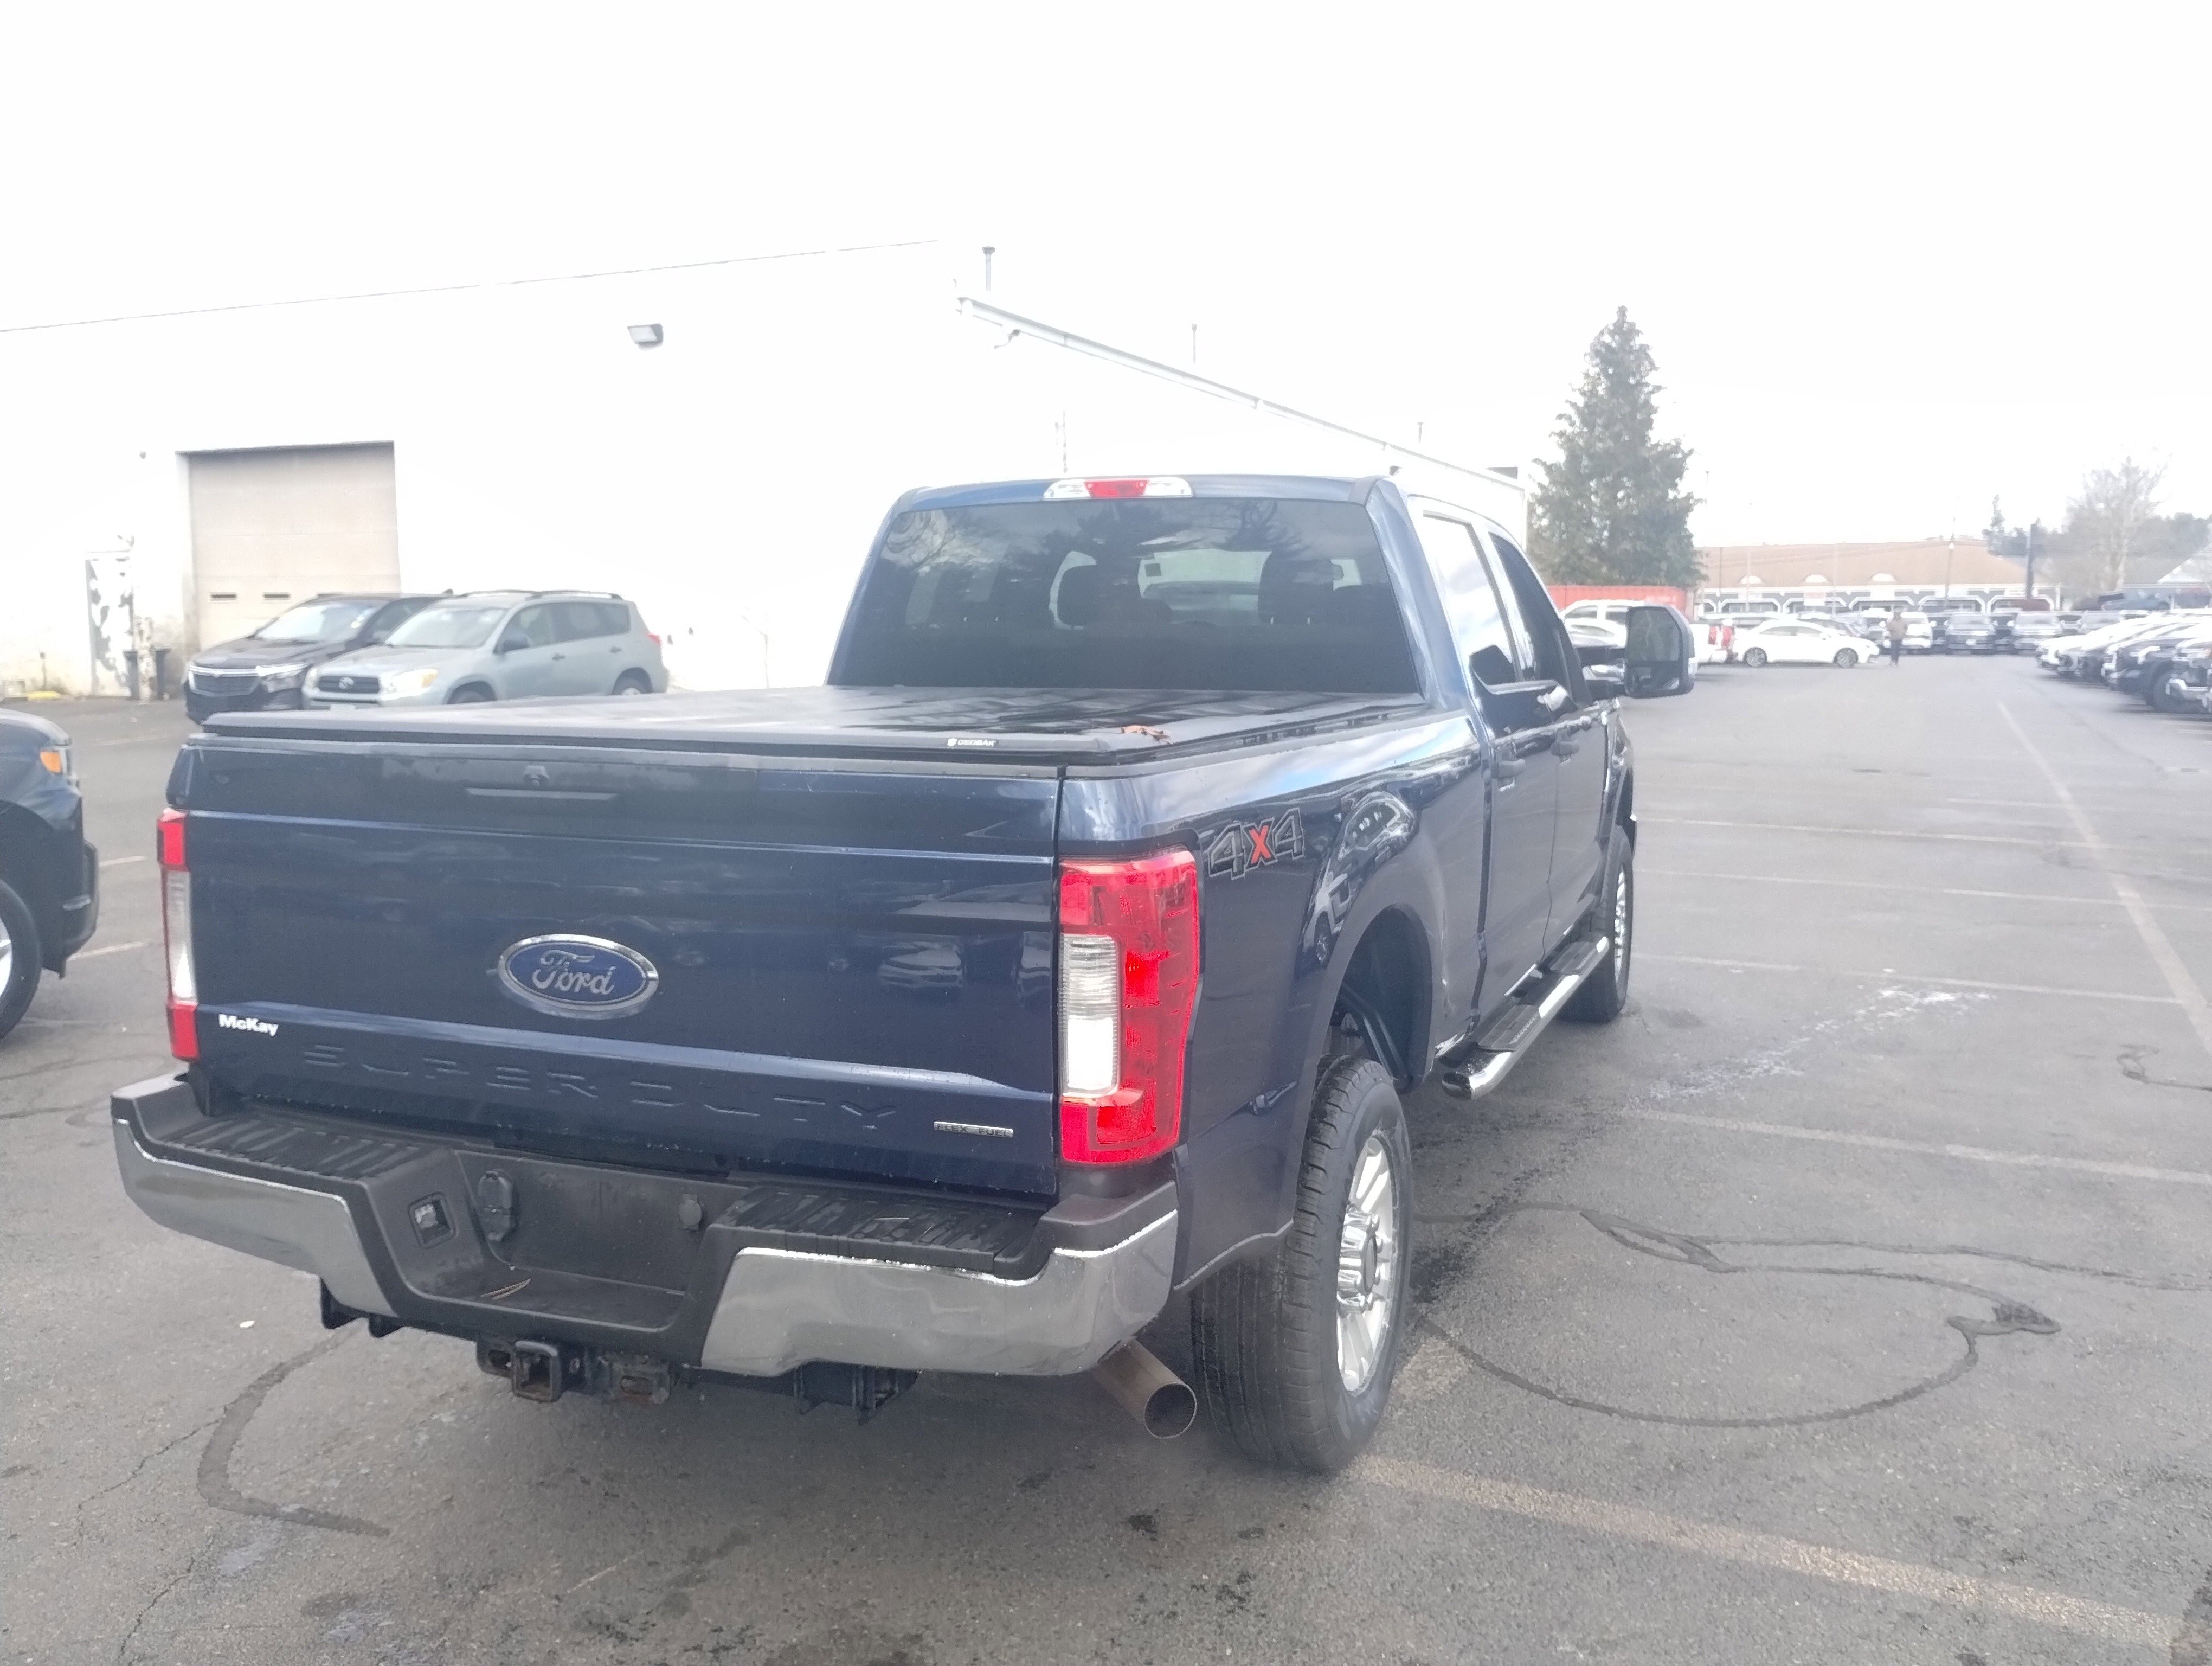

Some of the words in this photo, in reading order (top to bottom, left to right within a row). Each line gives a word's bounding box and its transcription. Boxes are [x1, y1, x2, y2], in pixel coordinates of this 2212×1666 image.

[532, 950, 616, 995] Ford
[218, 1014, 279, 1036] McKay
[937, 1123, 968, 1133] FLEX
[978, 1127, 1013, 1137] FUEL
